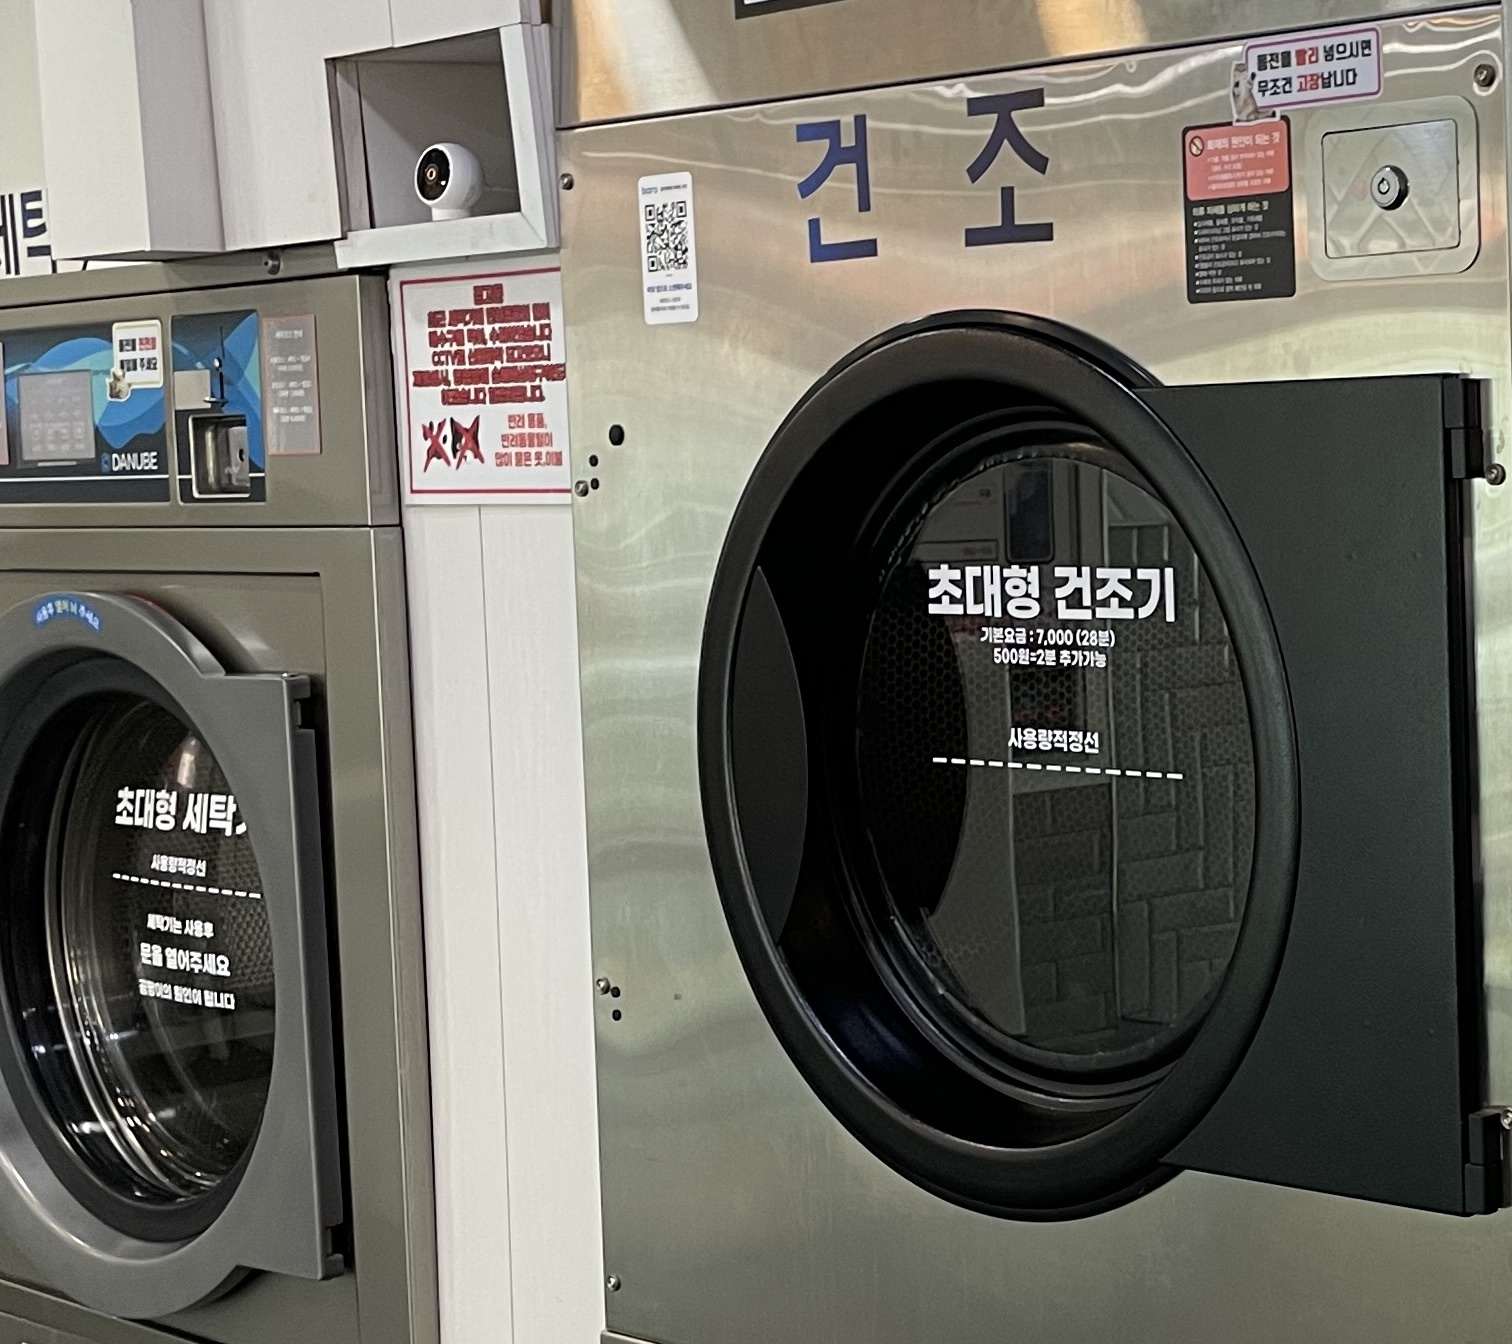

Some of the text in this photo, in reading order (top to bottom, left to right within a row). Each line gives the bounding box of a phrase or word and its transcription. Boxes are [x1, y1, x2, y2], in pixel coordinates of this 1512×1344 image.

[1254, 39, 1371, 78] 동전을 빨리 넣으시면
[1257, 68, 1357, 103] 무조건 고장납니다
[112, 451, 158, 472] DANUBE
[928, 563, 1175, 622] 초대형 건조기
[980, 627, 1026, 644] 기본요금
[1036, 629, 1073, 645] 7,000
[1076, 627, 1115, 649] (28분)
[994, 648, 1109, 667] 500원=2분 추가가능
[1008, 728, 1099, 753] 사용량적정선
[115, 787, 247, 836] 초대형 세탁
[165, 947, 230, 976] 열어주세요
[204, 990, 235, 1009] 됩니다
